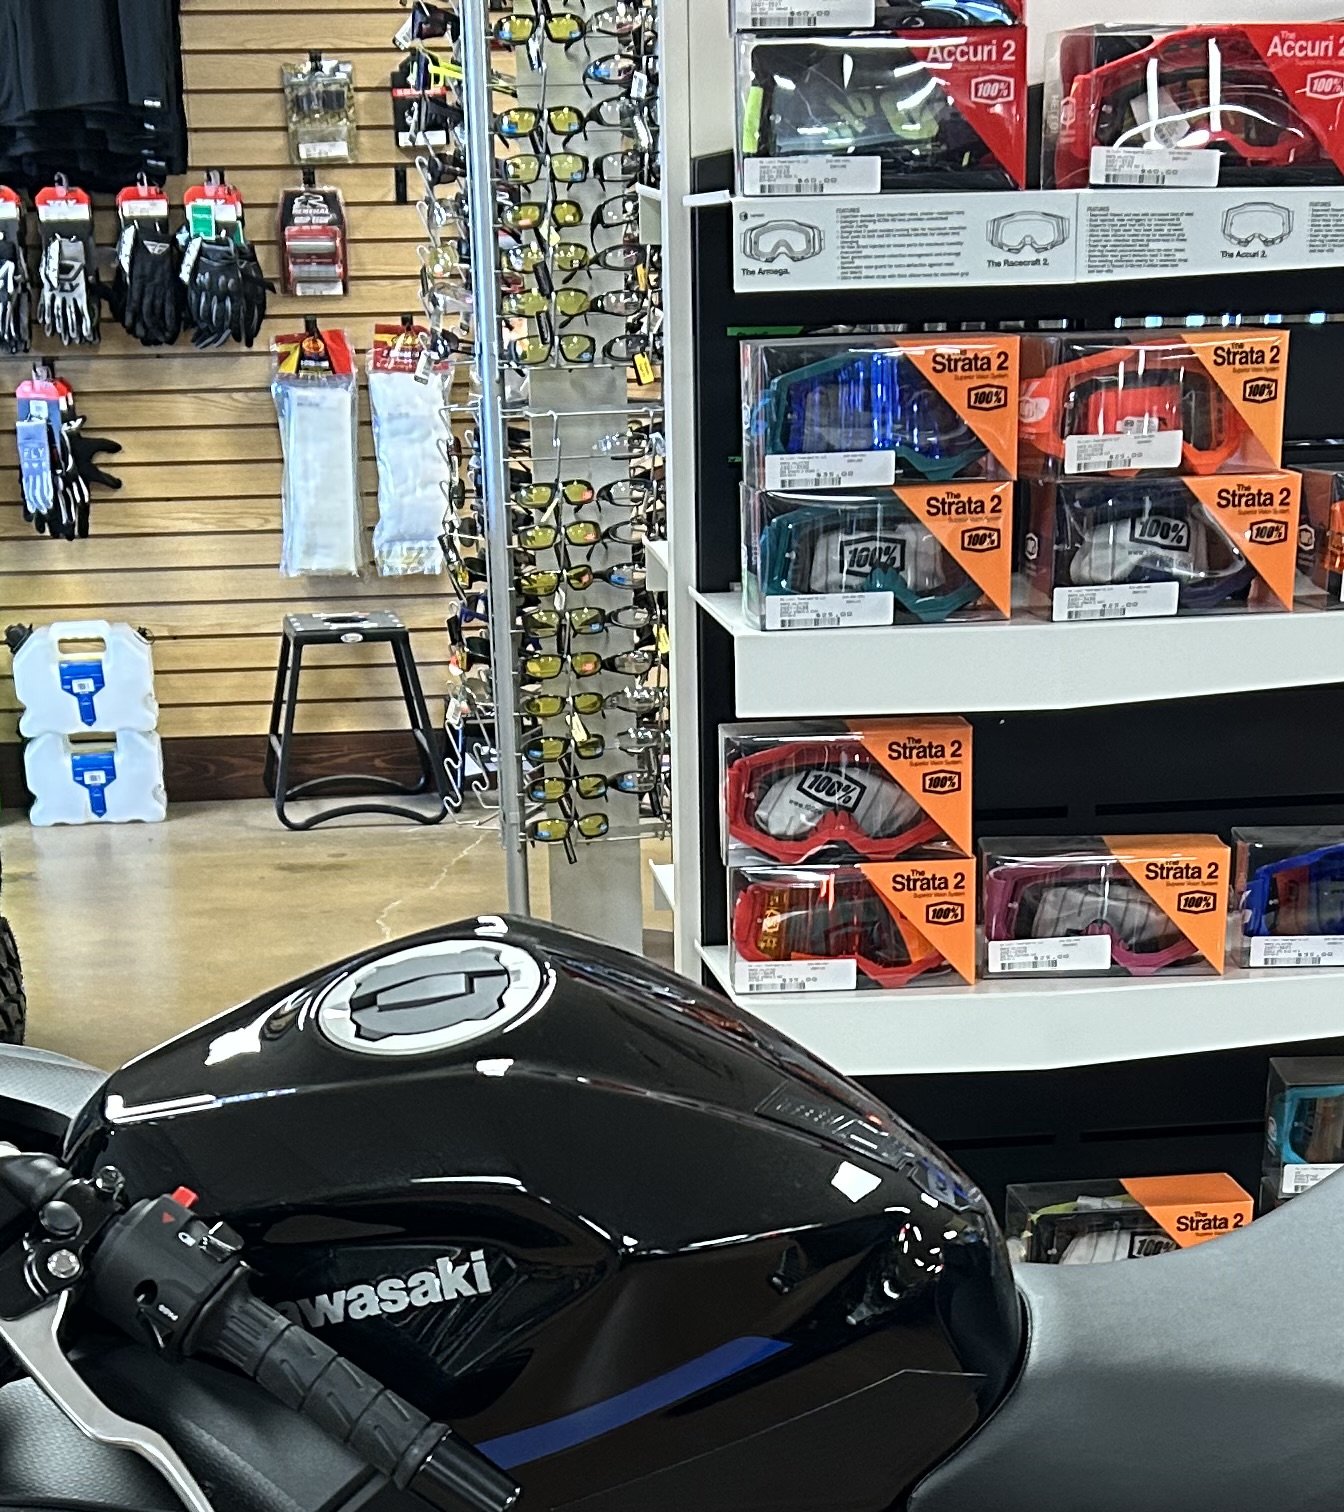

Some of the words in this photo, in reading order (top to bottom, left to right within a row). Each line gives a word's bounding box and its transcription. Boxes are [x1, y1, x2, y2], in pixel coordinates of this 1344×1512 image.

[1280, 31, 1296, 39] The
[926, 41, 997, 62] Accuri
[1002, 40, 1016, 61] 2
[1267, 36, 1333, 57] Accuri
[976, 81, 1009, 98] 100%
[1311, 79, 1344, 93] 100%
[932, 352, 992, 373] Strata
[996, 351, 1009, 371] 2
[1213, 345, 1265, 366] Strata
[1269, 345, 1280, 364] 2
[973, 390, 1003, 404] 100%
[1247, 383, 1273, 397] 100%
[945, 492, 961, 500] The
[1236, 483, 1252, 492] The
[926, 496, 985, 516] Strata
[990, 494, 1002, 514] 2
[1216, 488, 1274, 508] Strata
[1279, 487, 1291, 507] 2
[966, 533, 996, 546] 100%
[1139, 518, 1186, 545] 100%
[1254, 526, 1283, 539] 100%
[906, 736, 922, 744] The
[887, 741, 946, 760] Strata
[950, 740, 962, 758] 2
[806, 774, 856, 804] 100%
[927, 776, 956, 789] 100%
[910, 869, 925, 877] The
[1145, 863, 1202, 880] Strata
[1207, 862, 1219, 879] 2
[891, 874, 949, 892] Strata
[953, 872, 965, 889] 2
[1183, 896, 1211, 908] 100%
[930, 906, 959, 919] 100%
[1176, 1214, 1229, 1231] Strata
[1233, 1213, 1244, 1228] 2
[274, 1249, 492, 1328] awasaki
